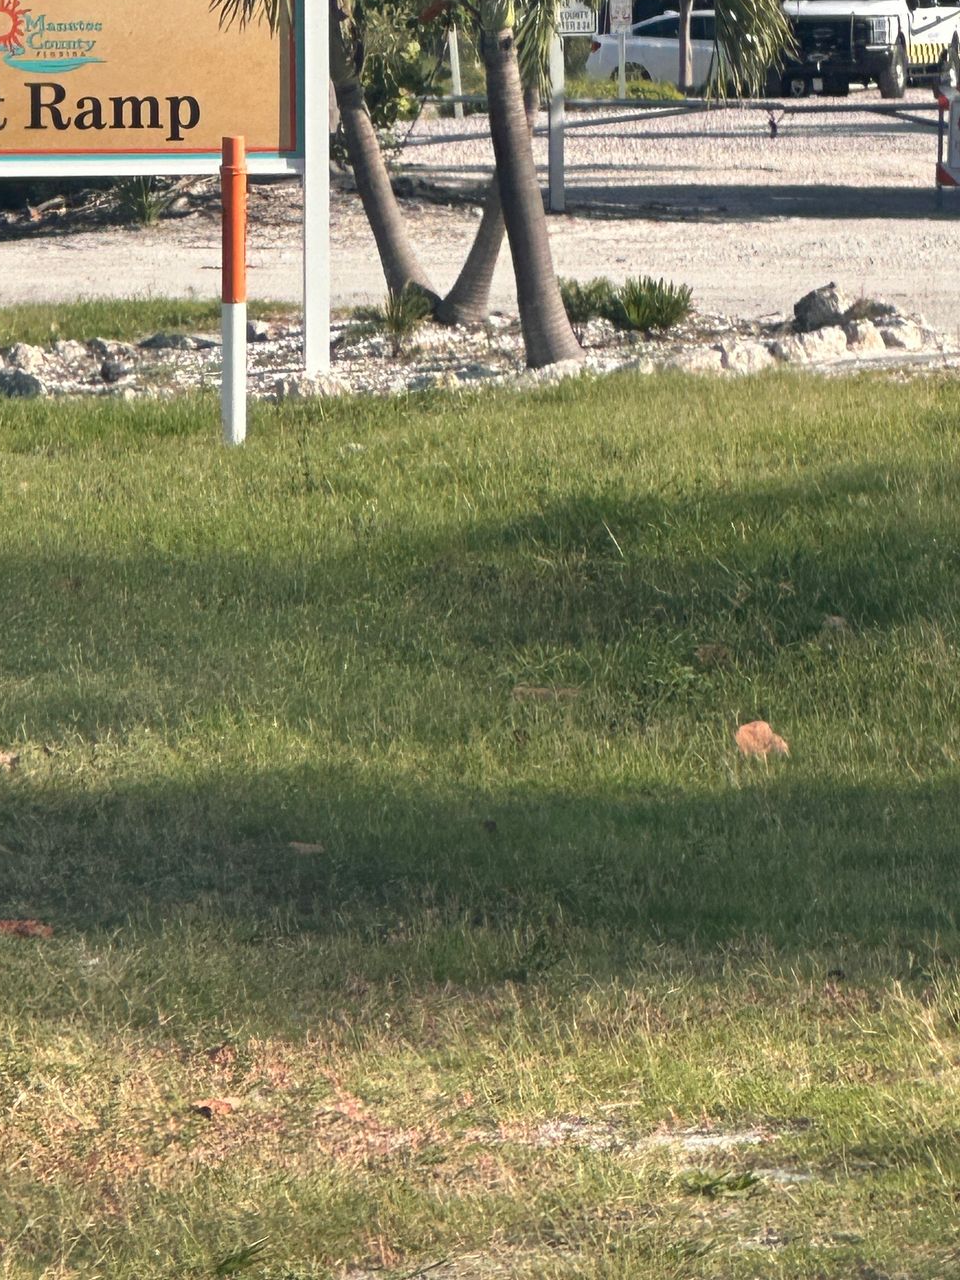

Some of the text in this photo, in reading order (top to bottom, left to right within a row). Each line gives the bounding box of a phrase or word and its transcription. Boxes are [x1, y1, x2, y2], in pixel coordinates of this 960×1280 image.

[23, 14, 103, 33] Manatee
[26, 31, 96, 52] County
[24, 82, 201, 141] Ramp
